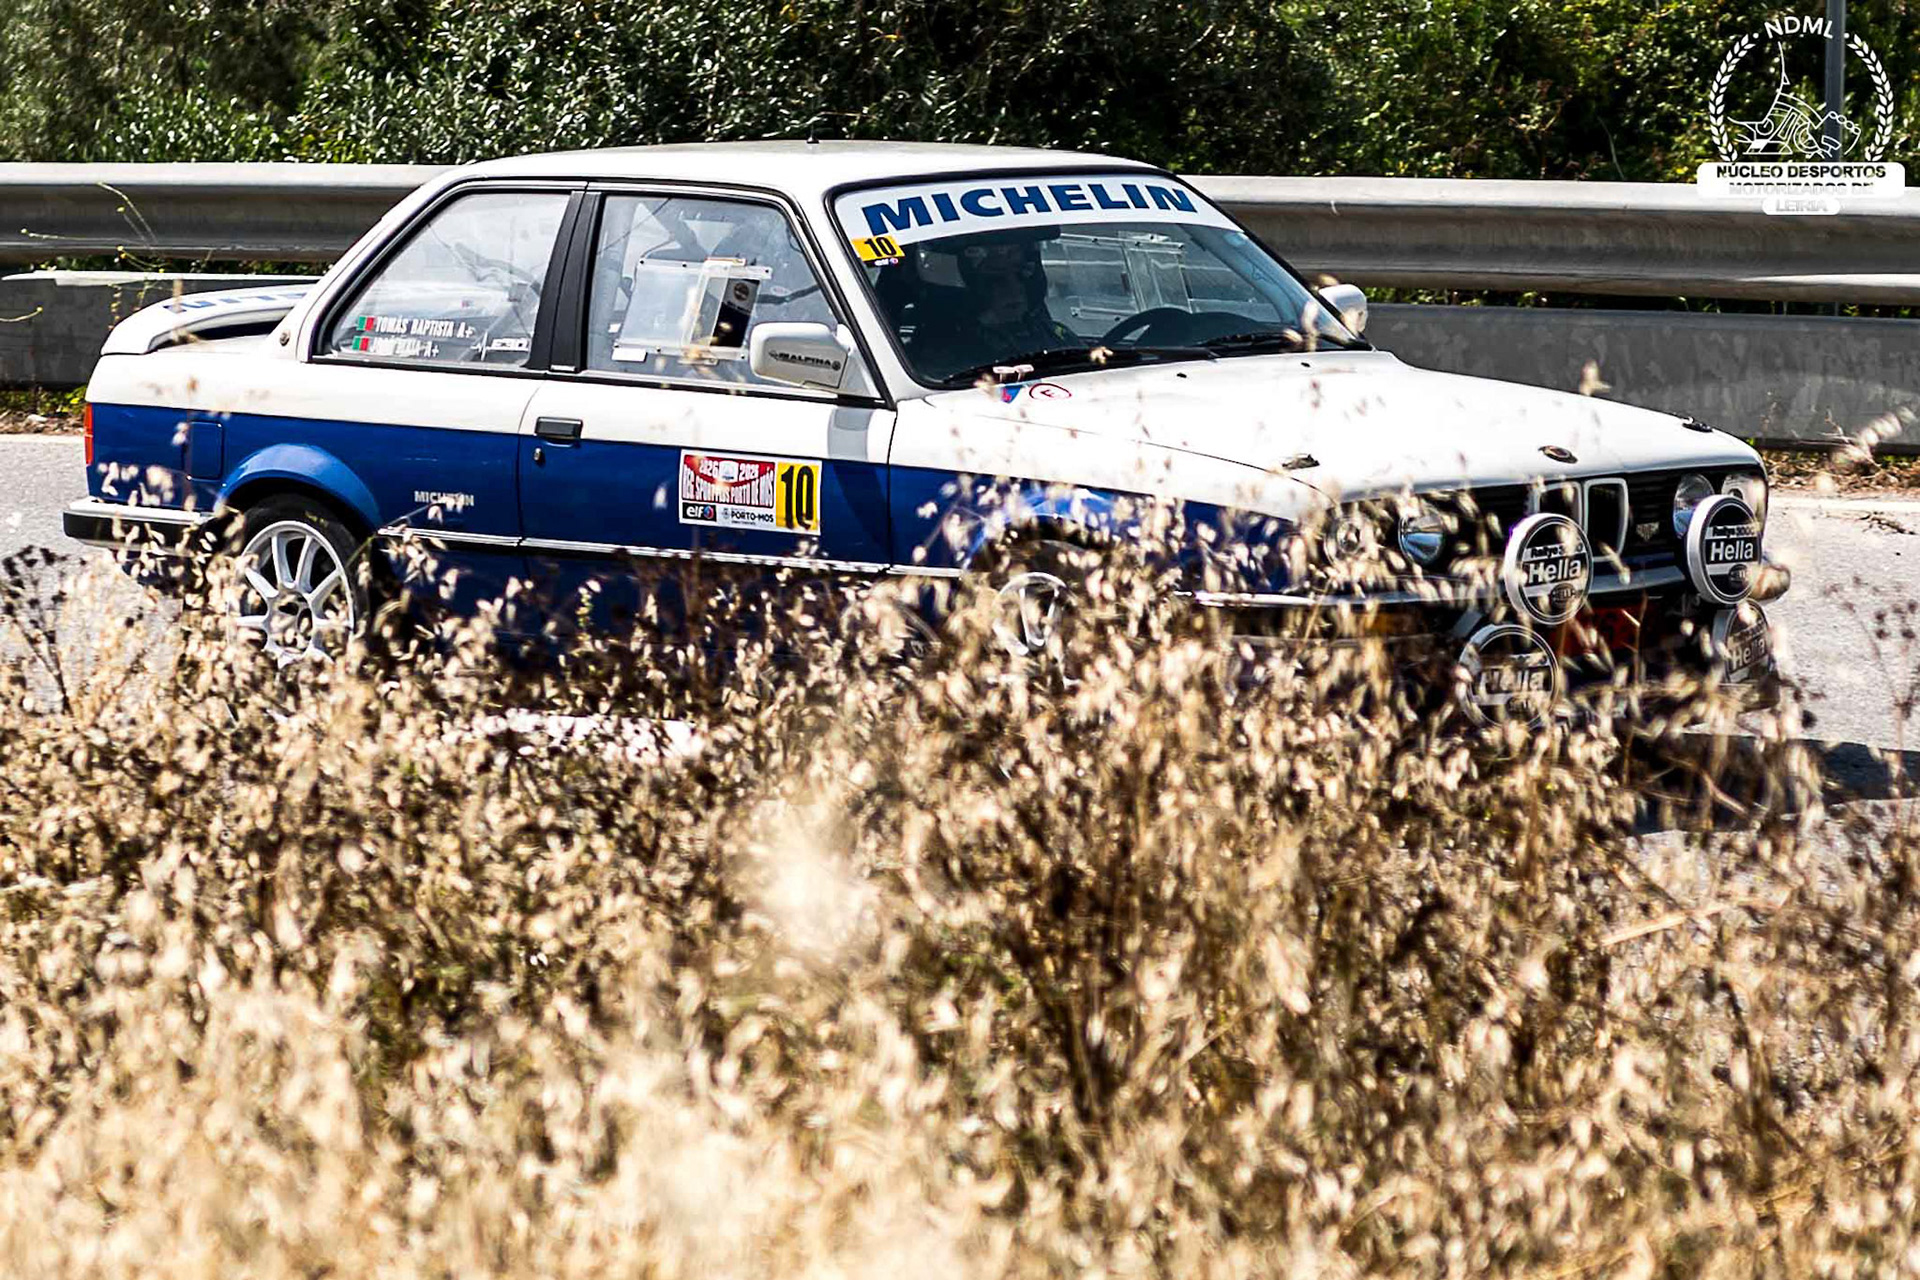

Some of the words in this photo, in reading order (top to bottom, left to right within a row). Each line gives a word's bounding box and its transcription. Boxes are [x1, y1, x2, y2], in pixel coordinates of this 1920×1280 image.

[861, 183, 1198, 236] MICHELIN
[863, 236, 897, 258] 10
[375, 315, 409, 334] TOMÁS
[410, 318, 454, 338] BAPTISTA
[456, 322, 474, 339] A+
[790, 353, 832, 367] ALPINA
[414, 490, 474, 506] MICHN
[780, 465, 815, 530] 10
[686, 506, 704, 518] elf
[1710, 540, 1754, 561] Hella
[1528, 558, 1582, 584] Hella
